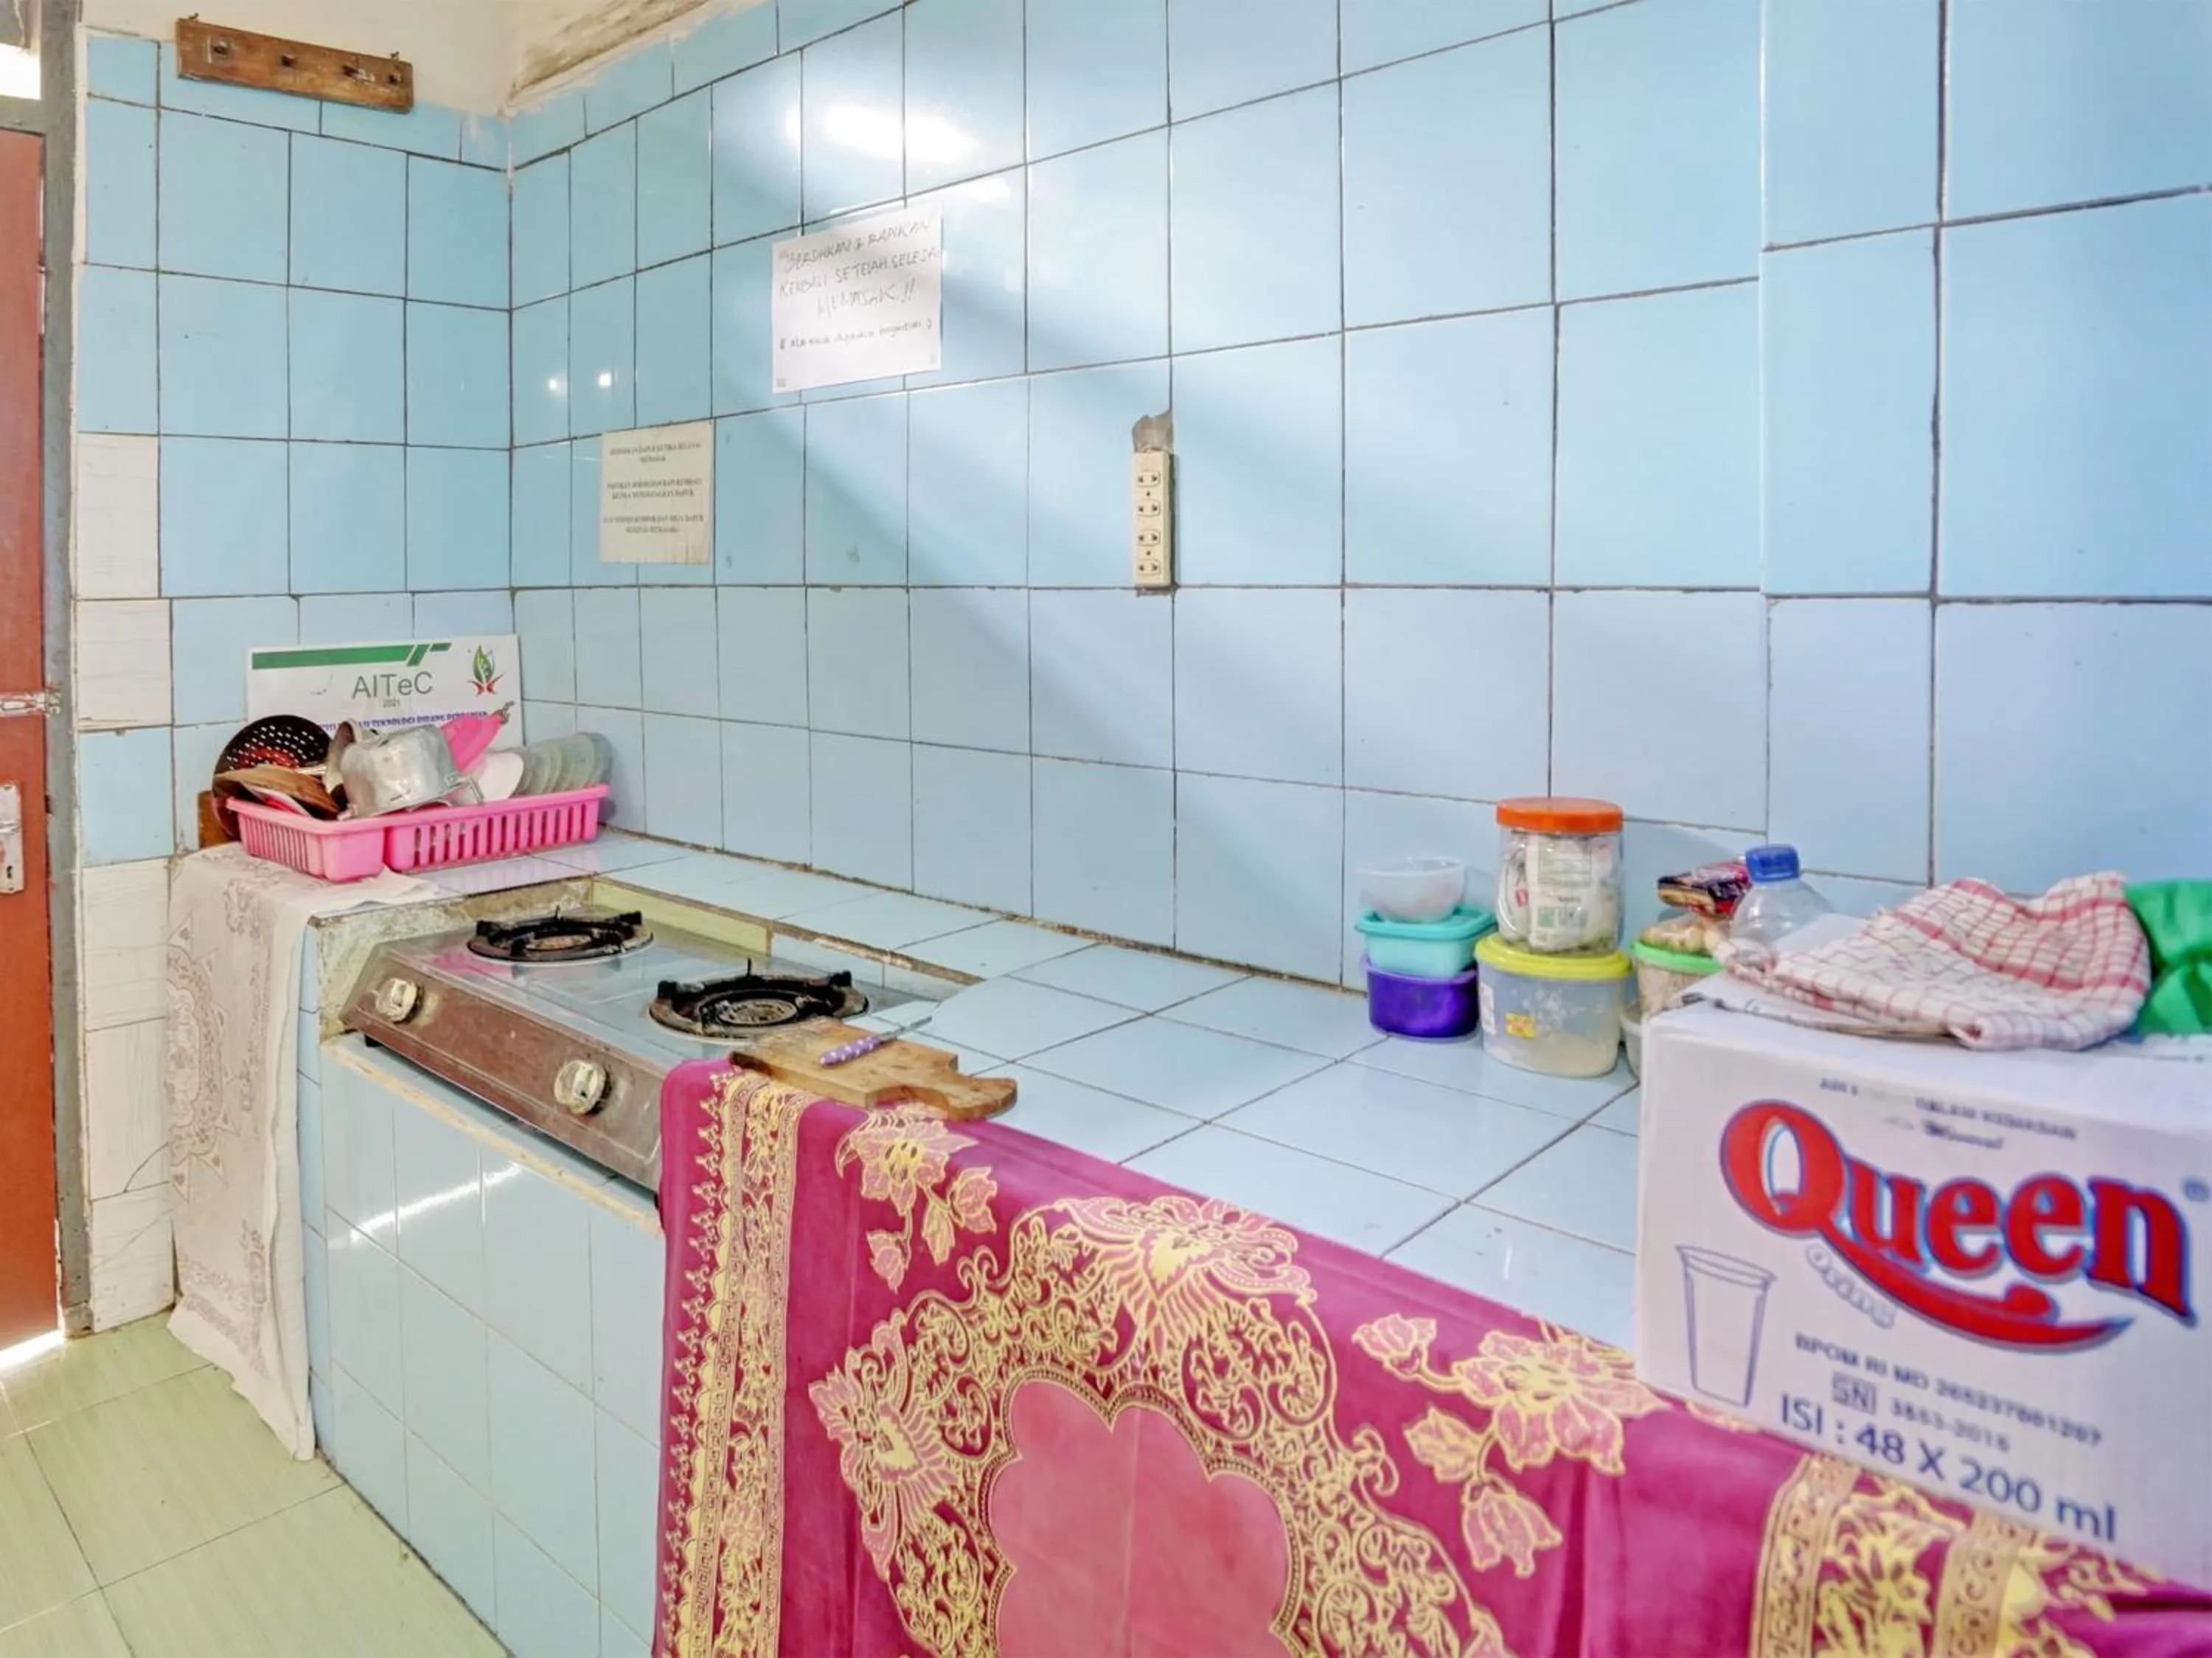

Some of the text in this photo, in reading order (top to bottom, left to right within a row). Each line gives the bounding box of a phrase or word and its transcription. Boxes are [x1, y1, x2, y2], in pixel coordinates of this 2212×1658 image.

[1719, 1098, 2197, 1353] Queen
[1794, 1331, 1859, 1367] BPOM
[1893, 1363, 1930, 1390] MD
[1780, 1392, 1825, 1437] ISI
[1855, 1423, 1905, 1466] 48
[1917, 1443, 1947, 1481] X
[1958, 1458, 2042, 1514] 200
[2056, 1504, 2117, 1543] ml
